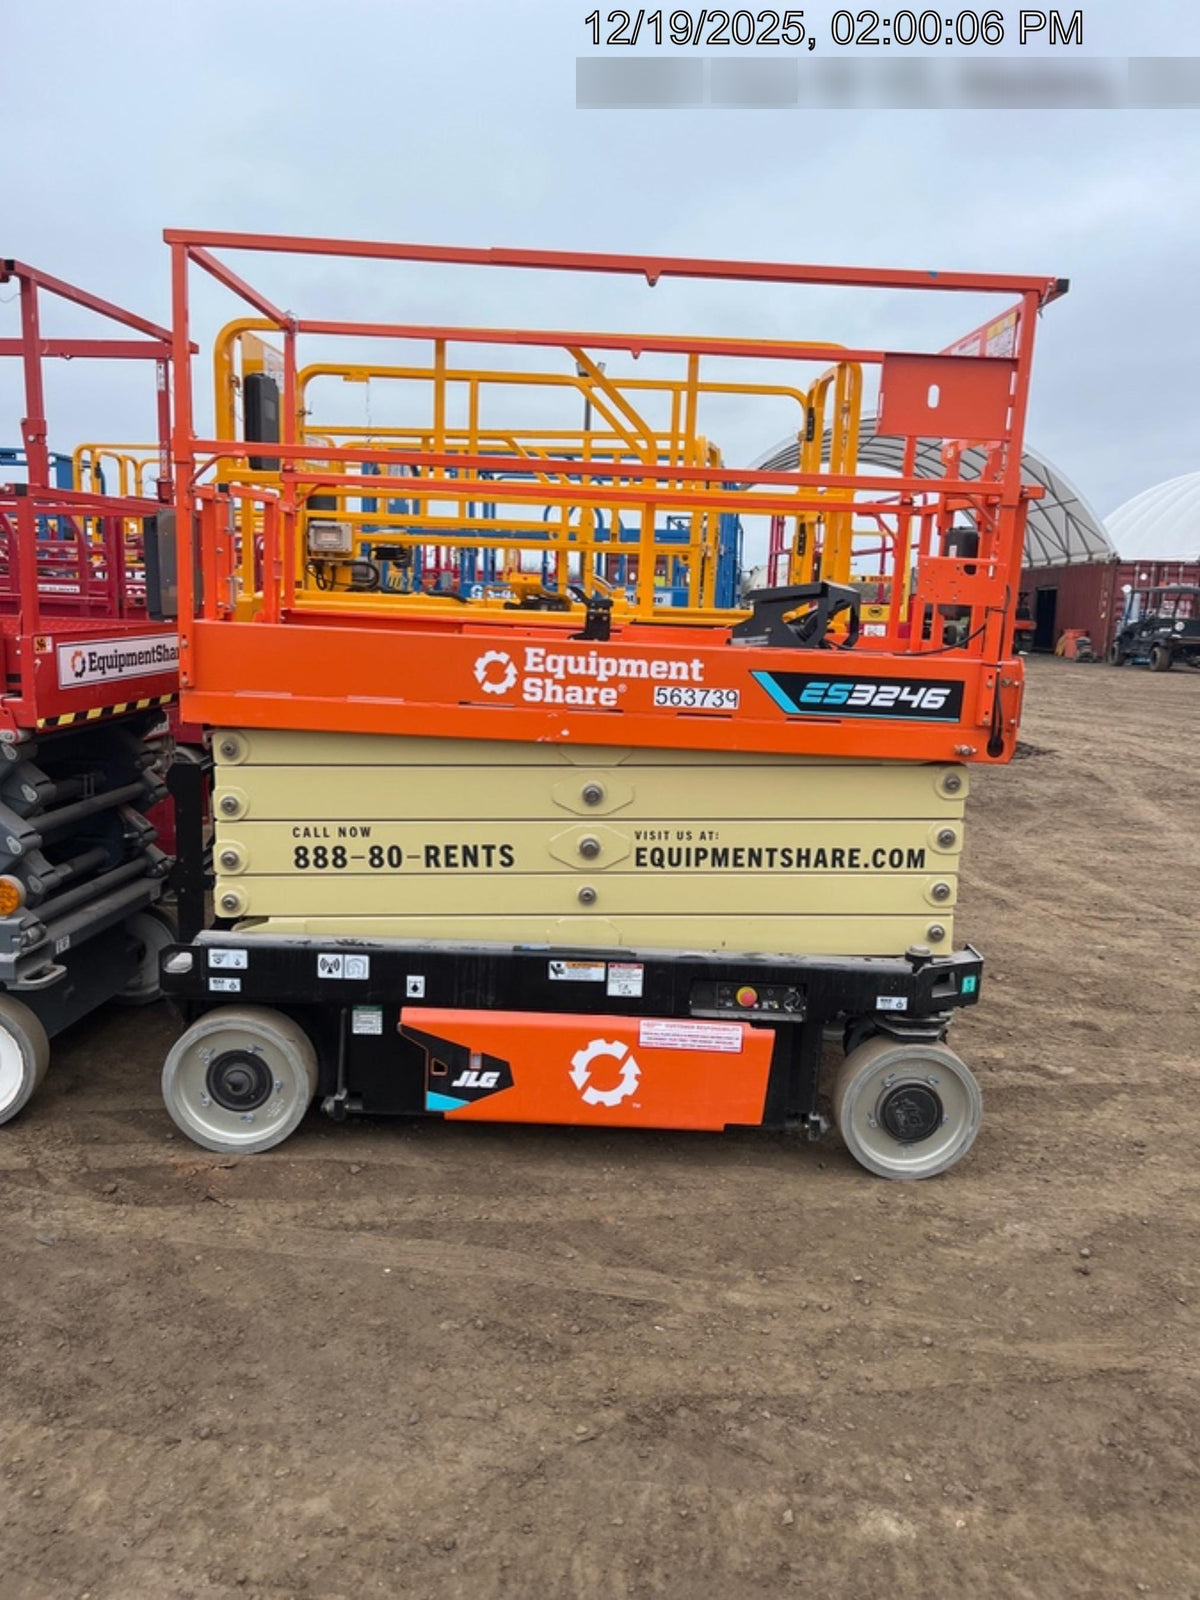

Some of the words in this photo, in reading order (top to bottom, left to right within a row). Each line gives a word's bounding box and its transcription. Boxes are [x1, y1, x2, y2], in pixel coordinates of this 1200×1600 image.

[524, 647, 705, 682] Equipment
[655, 687, 739, 708] 563739
[799, 681, 951, 709] ES3246
[292, 826, 331, 838] CALL
[337, 826, 372, 838] NOW
[634, 830, 670, 841] VISIT
[676, 830, 693, 841] US
[699, 830, 720, 841] AT:
[294, 844, 515, 869] 888-80-RENTS
[635, 846, 926, 869] EQUIPMENTSHARE.COM
[452, 1070, 500, 1089] JLG
